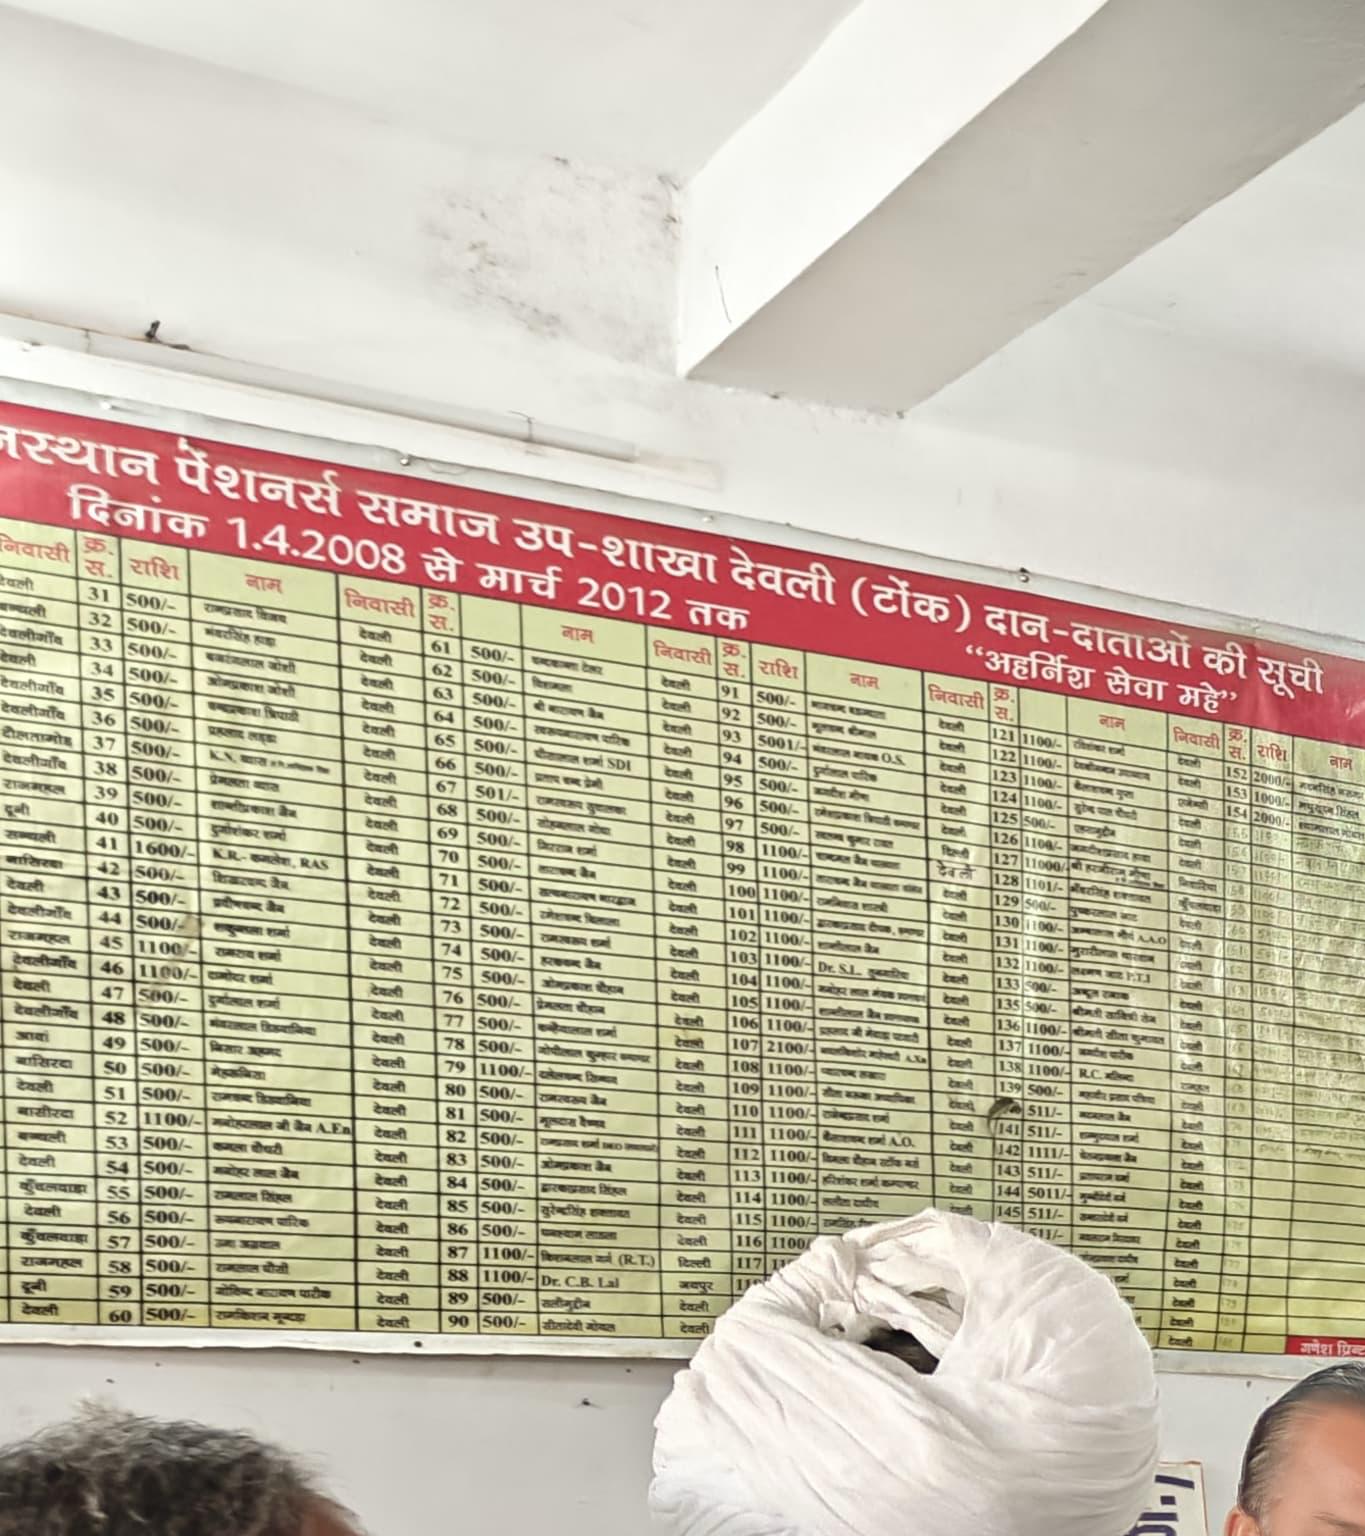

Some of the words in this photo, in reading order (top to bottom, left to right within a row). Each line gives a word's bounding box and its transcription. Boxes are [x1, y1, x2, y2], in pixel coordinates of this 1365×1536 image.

[67, 483, 209, 540] दिनांक
[226, 517, 407, 575] 1.4.2008
[420, 547, 464, 584] से
[475, 561, 564, 601] मार्च
[577, 576, 672, 620] 2012
[684, 599, 750, 631] तक
[129, 557, 181, 582] राशि
[88, 586, 111, 604] 31
[126, 592, 178, 614] 500/-
[344, 587, 416, 619] निवासी
[356, 490, 501, 544] समाज
[512, 518, 717, 584] उप-शाखा
[729, 545, 837, 606] देवली
[1202, 643, 1248, 680] की
[1256, 655, 1325, 699] सूची
[431, 639, 451, 655] 61
[470, 645, 515, 663] 500/-
[760, 658, 799, 680] राशि
[720, 684, 740, 701] 91
[1105, 665, 1169, 702] सेवा
[1225, 765, 1248, 783] 152
[732, 1037, 759, 1051] 107
[999, 1081, 1022, 1094] 139
[447, 1268, 469, 1282] 88
[108, 1309, 132, 1323] 60
[146, 1307, 196, 1325] 500/-
[448, 1315, 469, 1328] 90
